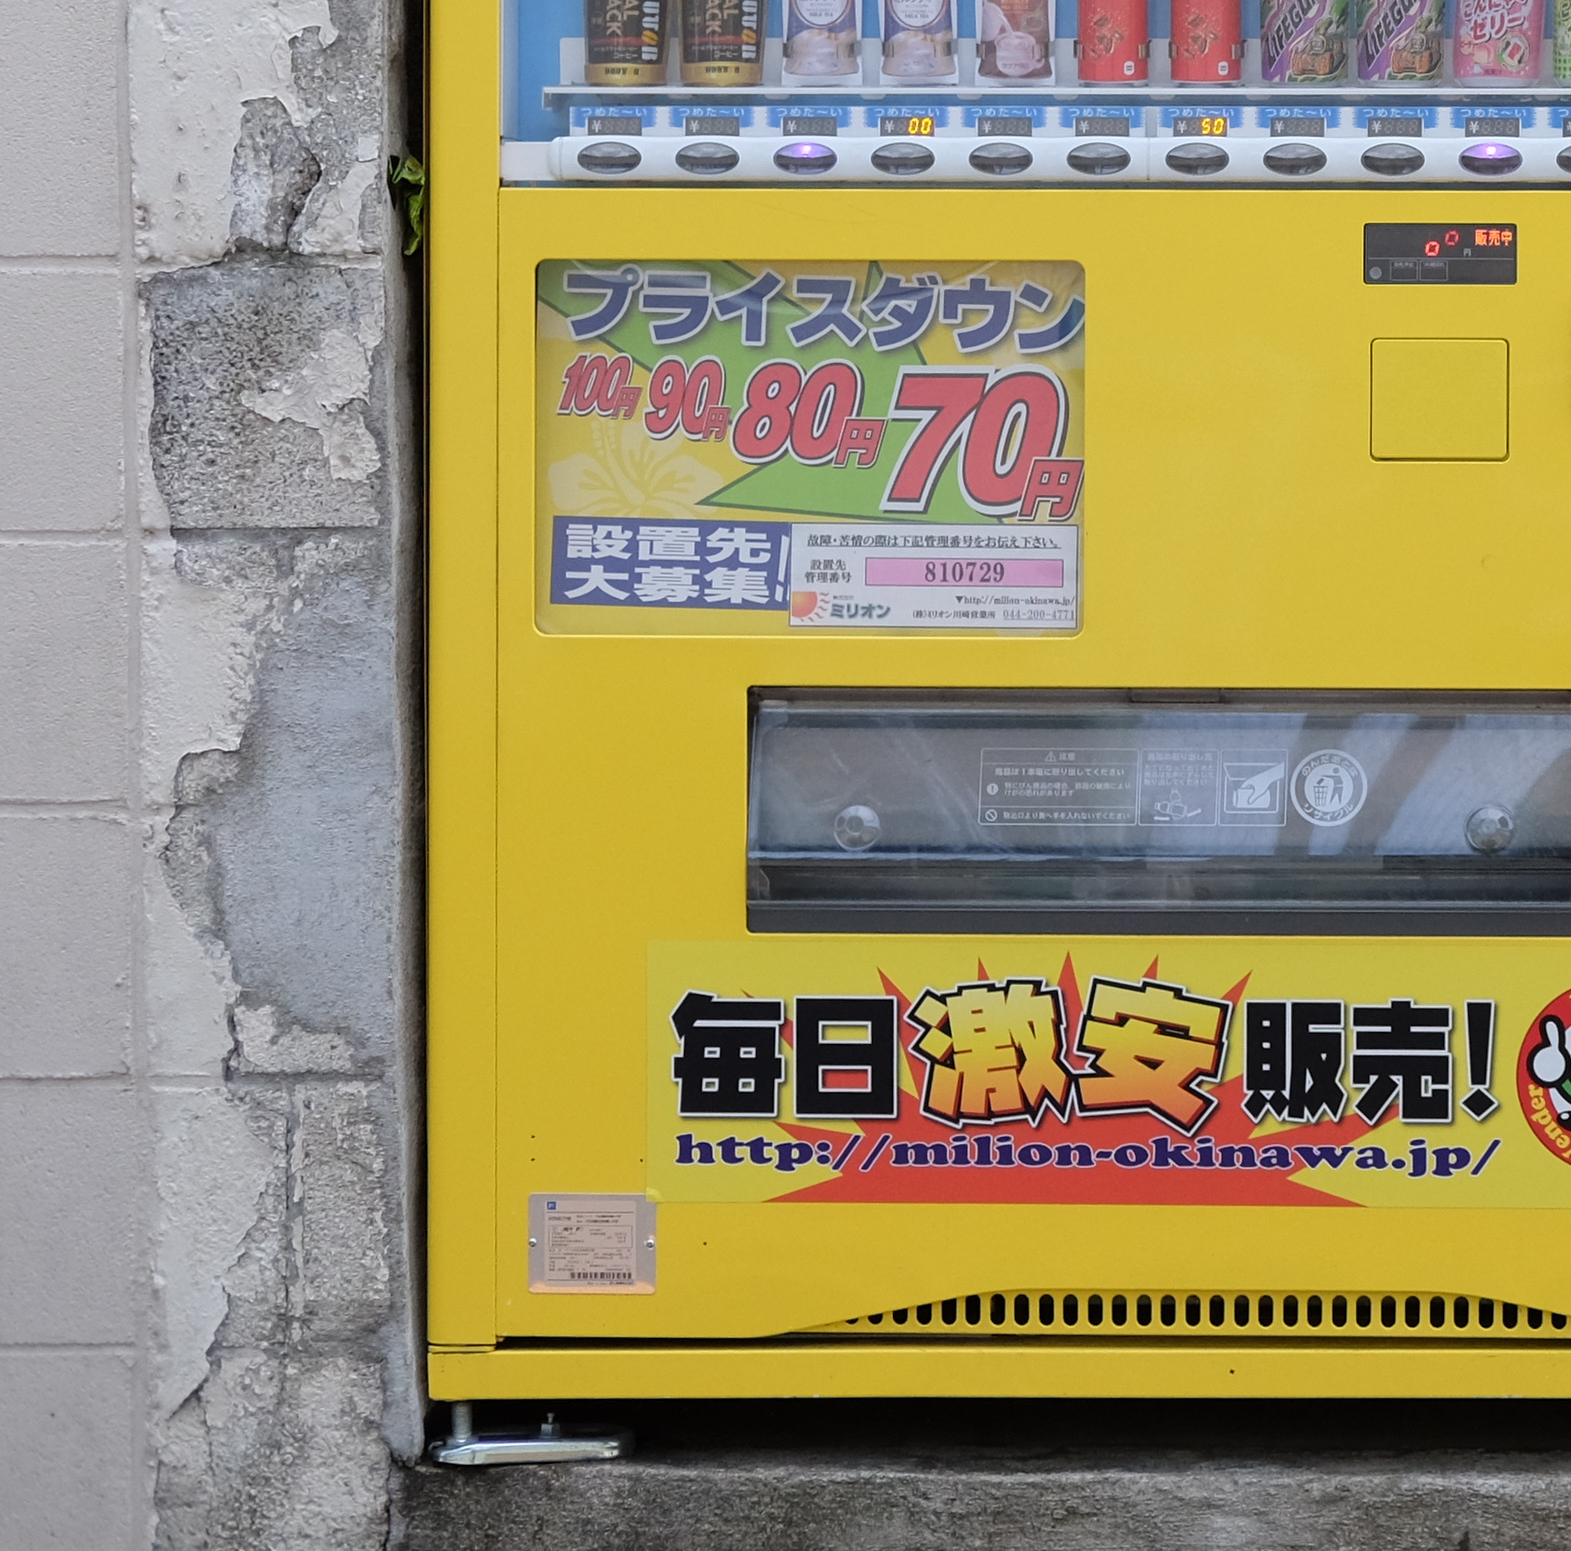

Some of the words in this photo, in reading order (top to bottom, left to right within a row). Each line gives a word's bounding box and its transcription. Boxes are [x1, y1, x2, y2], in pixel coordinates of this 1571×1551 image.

[1471, 13, 1525, 42] ゼリー
[1475, 229, 1513, 246] 販売中
[564, 265, 1085, 351] プライスダウン
[558, 355, 642, 419] 100円
[644, 356, 730, 442] 90円
[730, 359, 889, 470] 80円
[880, 366, 1085, 522] 70円
[566, 524, 773, 563] 設置先
[807, 534, 1061, 549] 故障・苦情の際は下記管理番号をお伝え下さい。
[810, 559, 846, 571] 設置先
[924, 562, 1005, 583] 810729
[805, 572, 852, 583] 管理番号
[829, 603, 891, 619] ミリオン
[1303, 803, 1353, 820] リサイクル
[670, 976, 1500, 1132] 毎日激安販売!
[674, 1131, 1500, 1180] http://milion-okinawa.jp/
